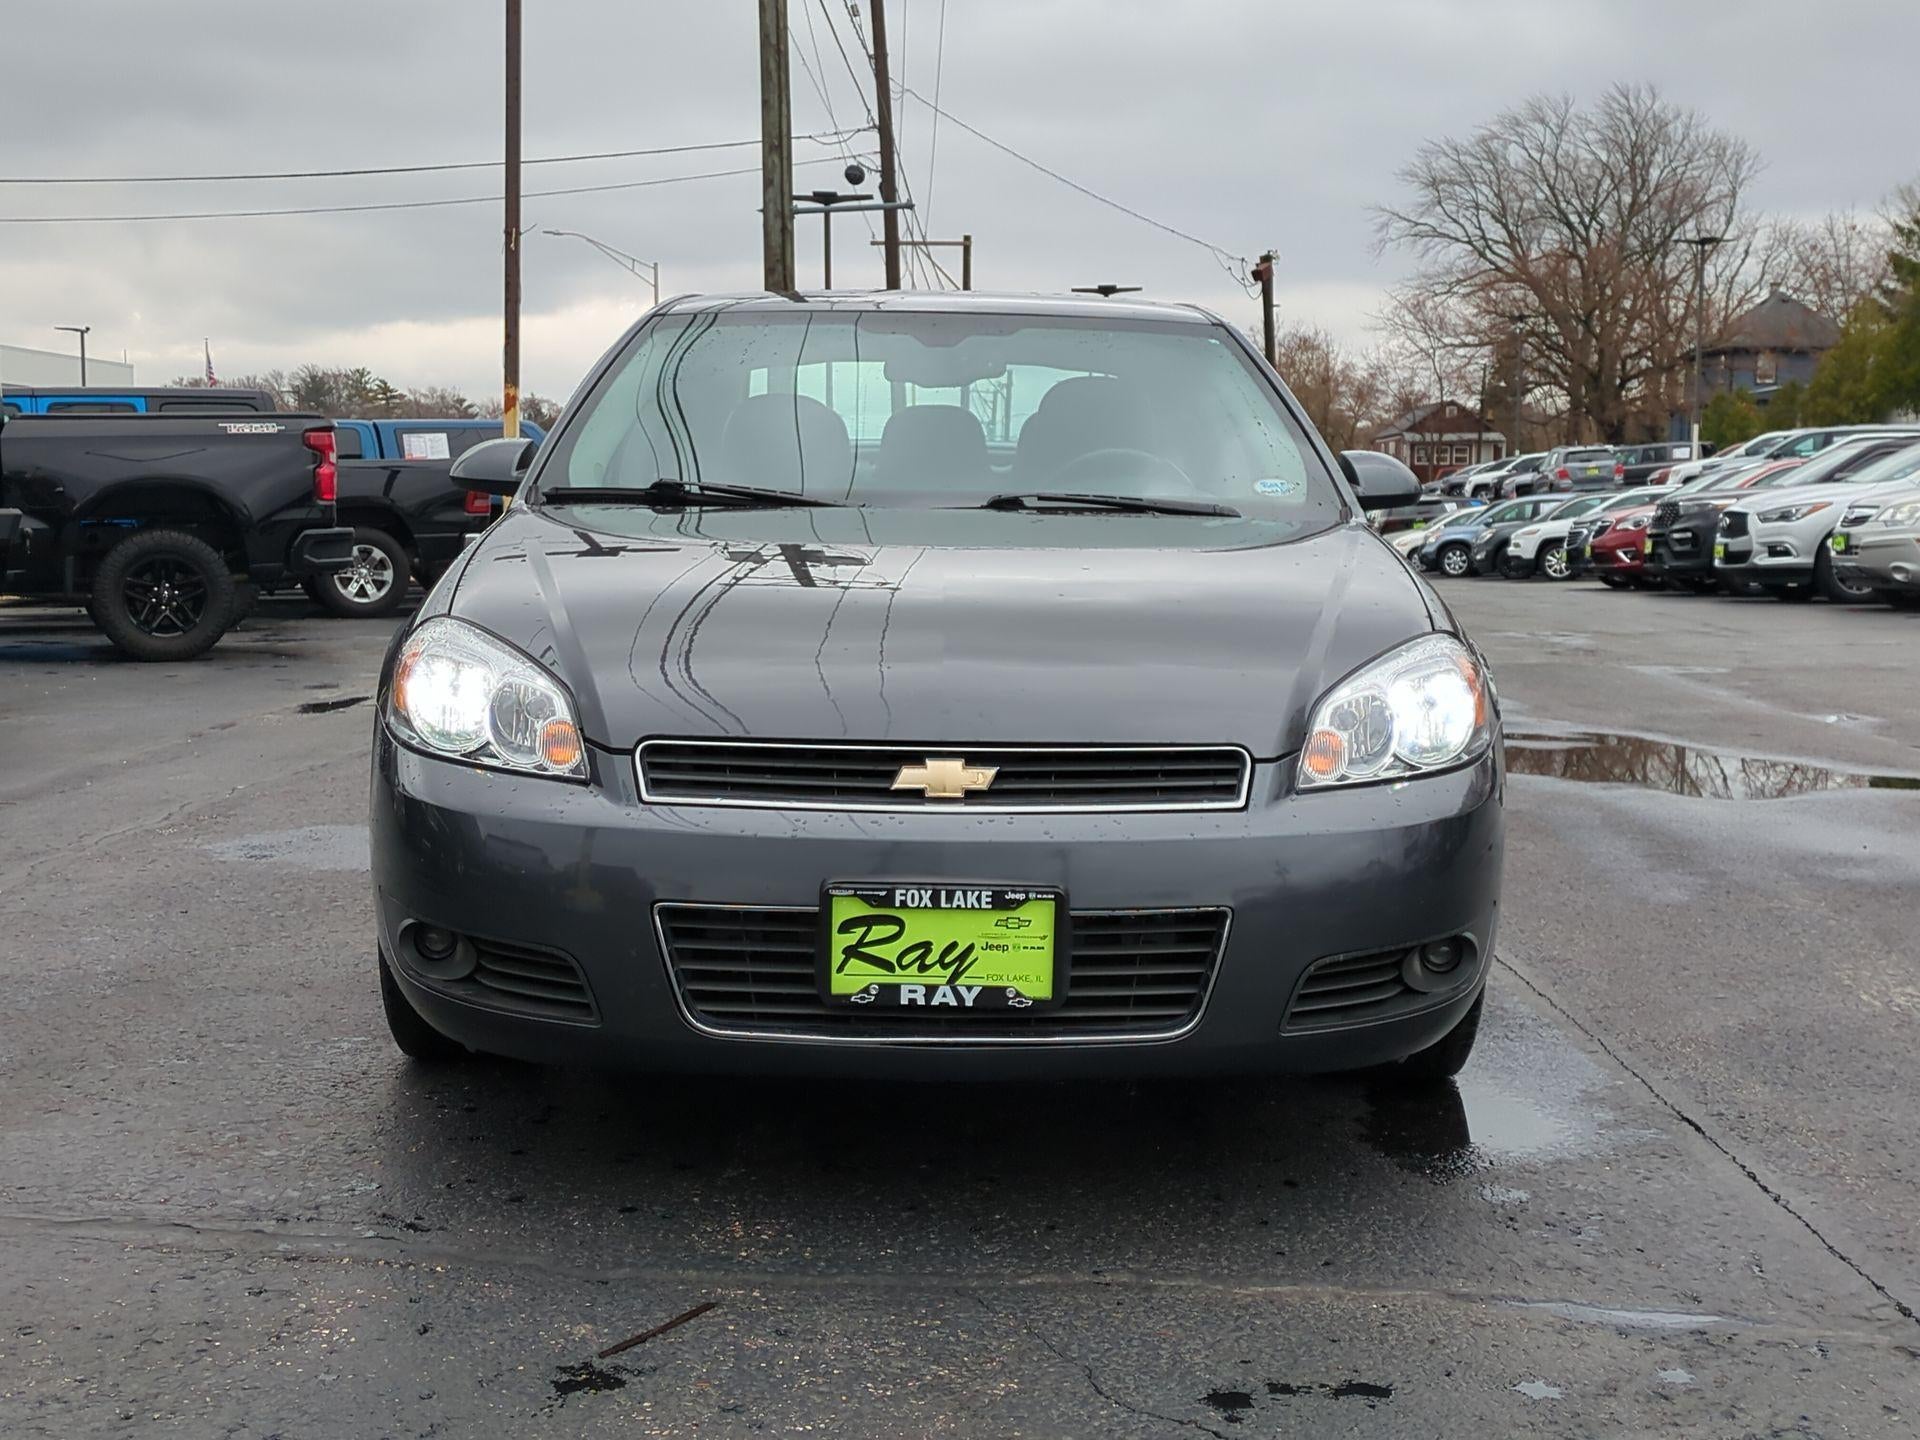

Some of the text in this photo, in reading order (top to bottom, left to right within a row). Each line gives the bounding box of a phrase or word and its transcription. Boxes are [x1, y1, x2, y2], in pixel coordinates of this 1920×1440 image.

[895, 889, 993, 909] FOX LAKE
[1005, 891, 1026, 900] Jeep
[836, 914, 979, 985] Ray
[981, 941, 1009, 953] Jeep
[986, 973, 1044, 983] FOX LAKE, IL
[900, 984, 983, 1007] RAY
